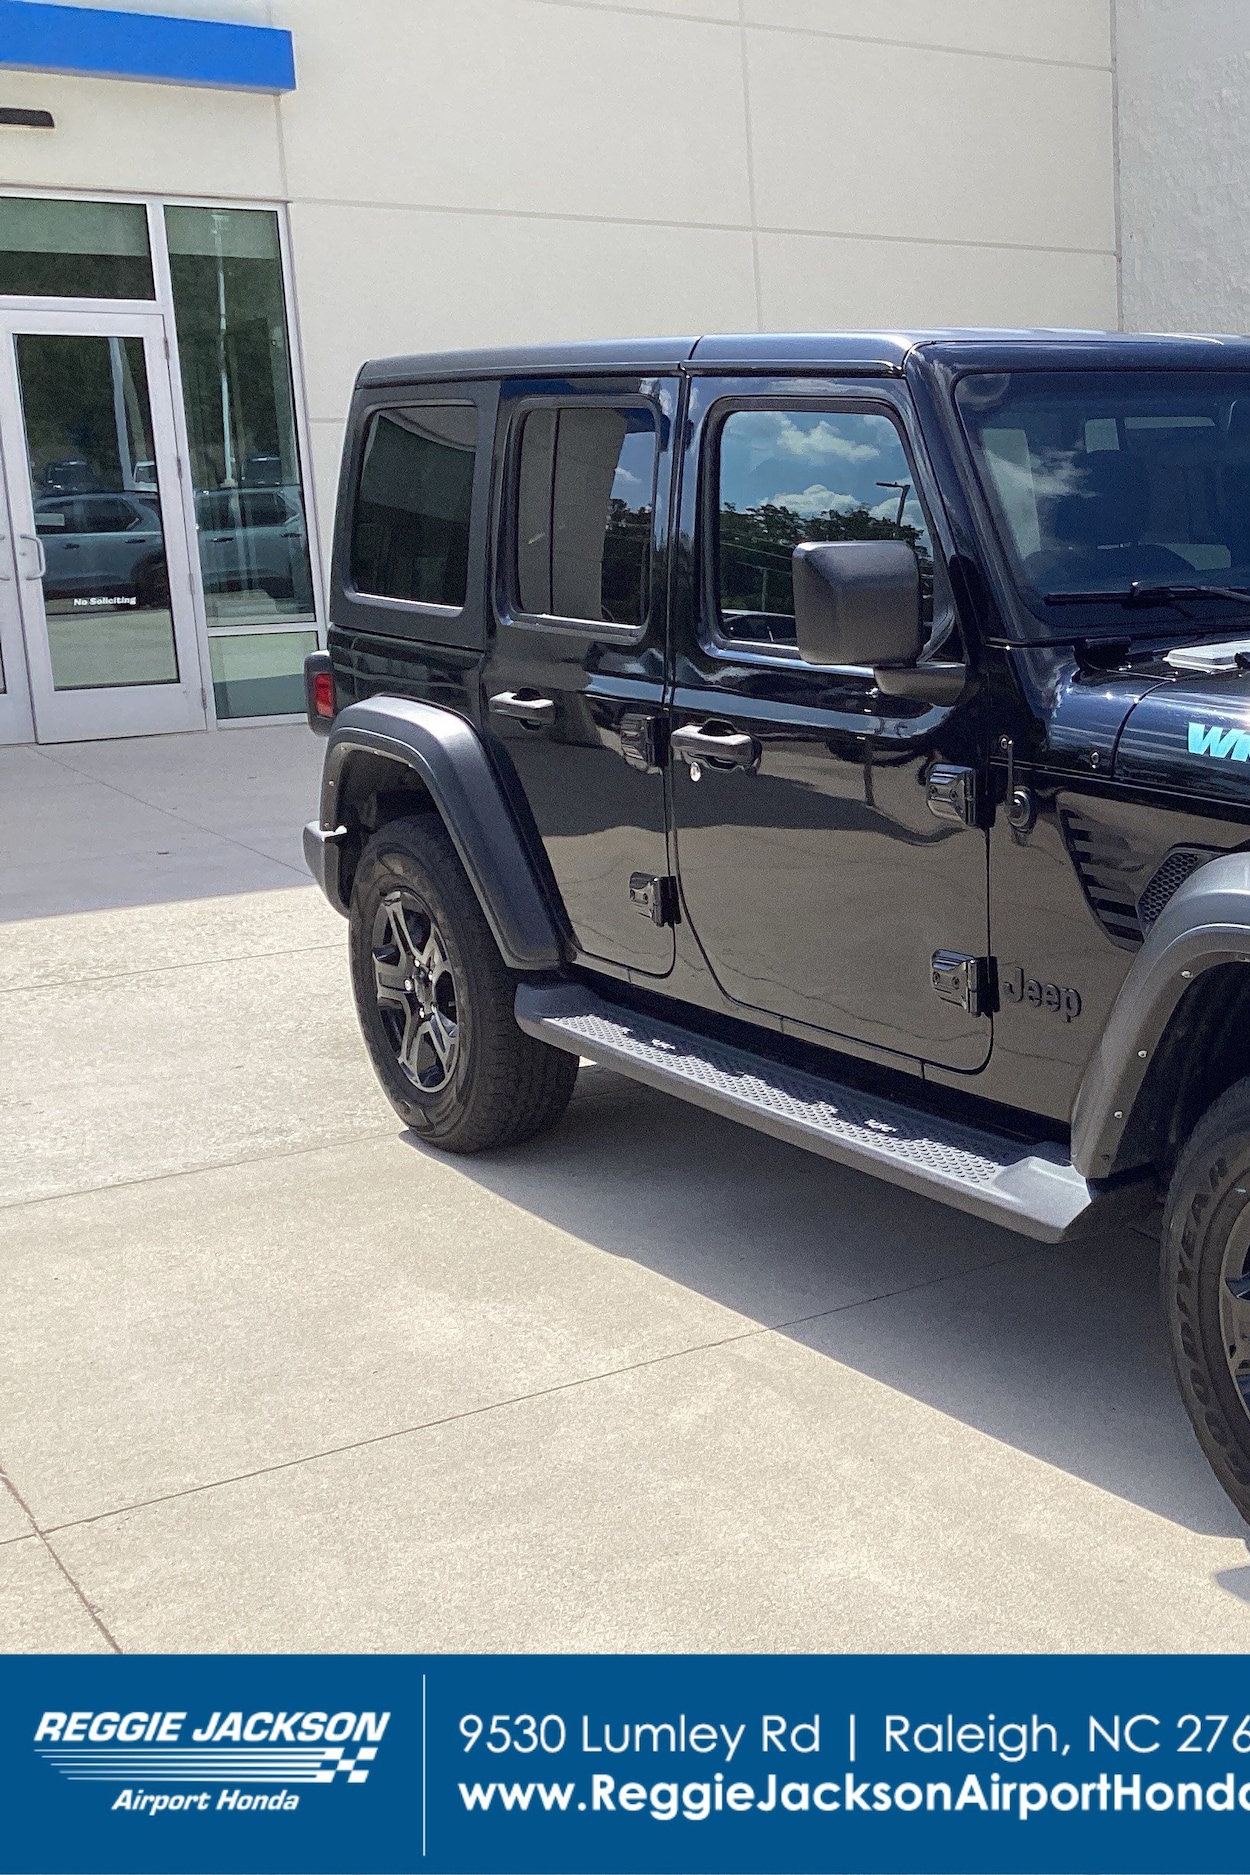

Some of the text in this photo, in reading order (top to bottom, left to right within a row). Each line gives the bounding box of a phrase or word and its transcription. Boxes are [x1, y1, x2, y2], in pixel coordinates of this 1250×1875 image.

[73, 596, 137, 606] No Soliciting
[1003, 965, 1082, 1024] Jeep
